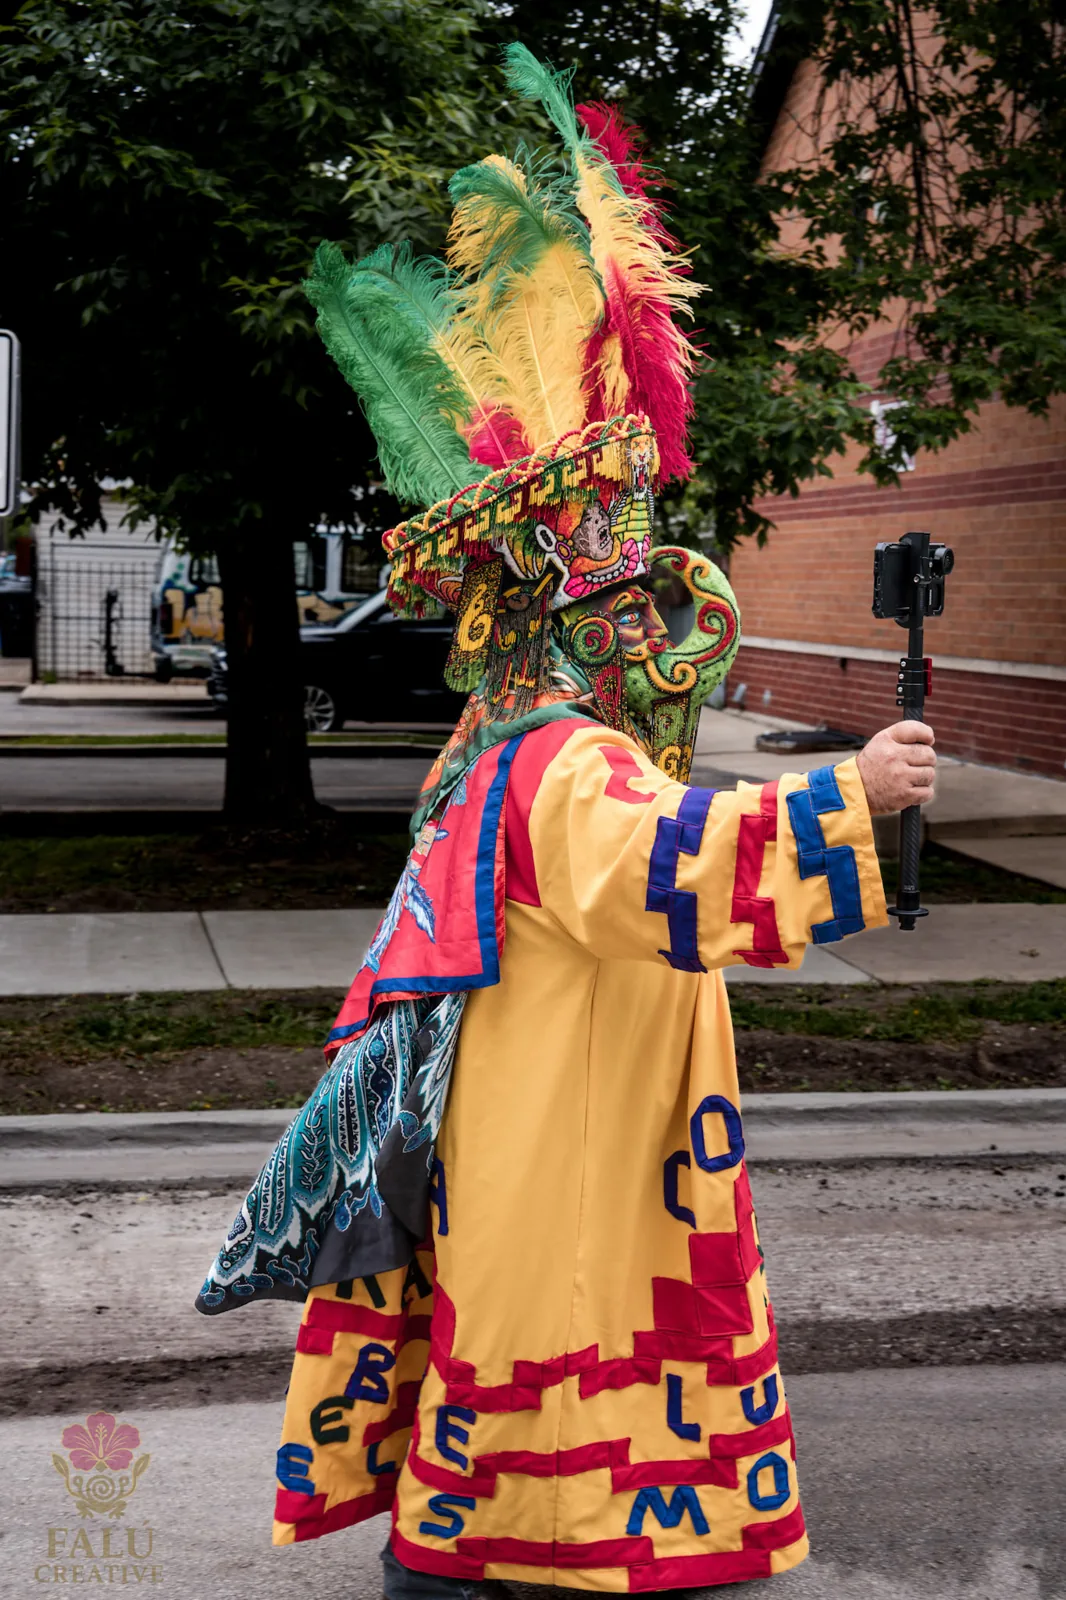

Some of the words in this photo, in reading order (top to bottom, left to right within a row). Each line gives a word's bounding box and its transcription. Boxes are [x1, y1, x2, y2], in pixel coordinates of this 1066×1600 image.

[663, 1094, 746, 1231] CO
[344, 1342, 396, 1405] B
[309, 1395, 355, 1445] E
[435, 1404, 477, 1471] E
[276, 1442, 315, 1496] E
[418, 1493, 477, 1539] S
